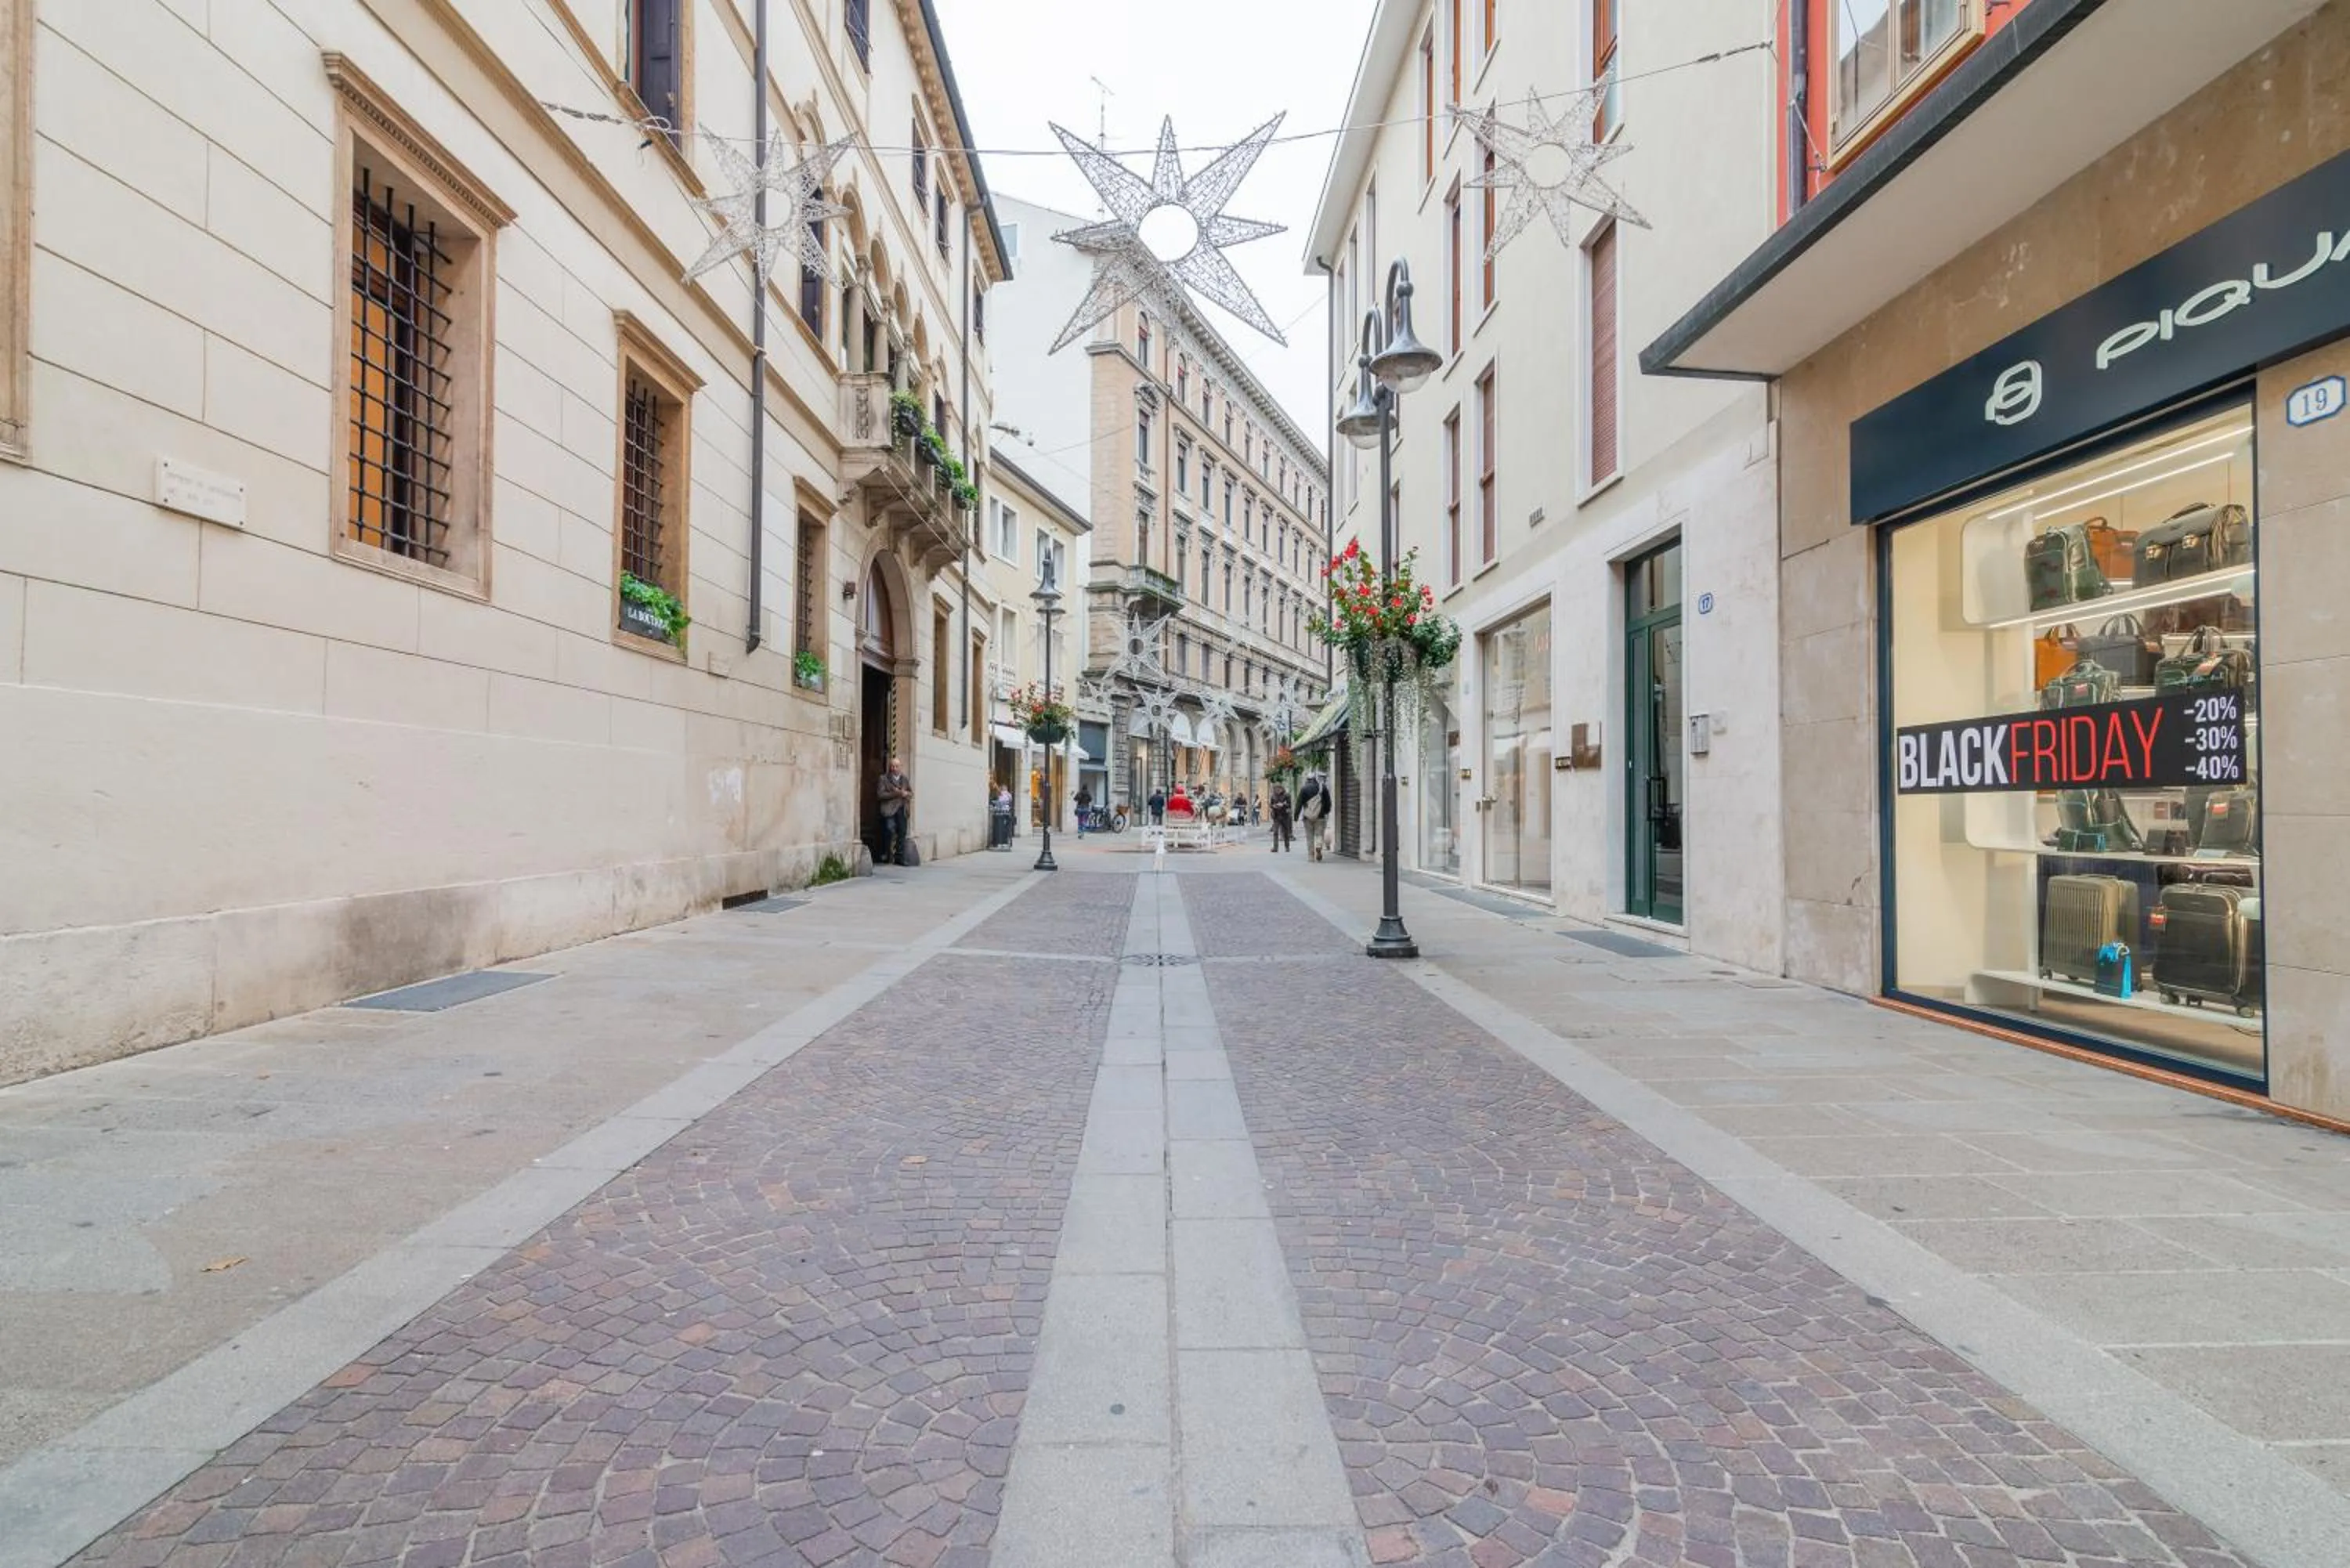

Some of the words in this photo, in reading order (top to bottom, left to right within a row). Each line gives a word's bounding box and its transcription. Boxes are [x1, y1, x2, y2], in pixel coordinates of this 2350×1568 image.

[2302, 388, 2327, 416] 19
[1701, 597, 1710, 610] 17
[2183, 695, 2237, 723] -20%
[2184, 724, 2239, 751] -30%
[2185, 754, 2240, 780] -40%
